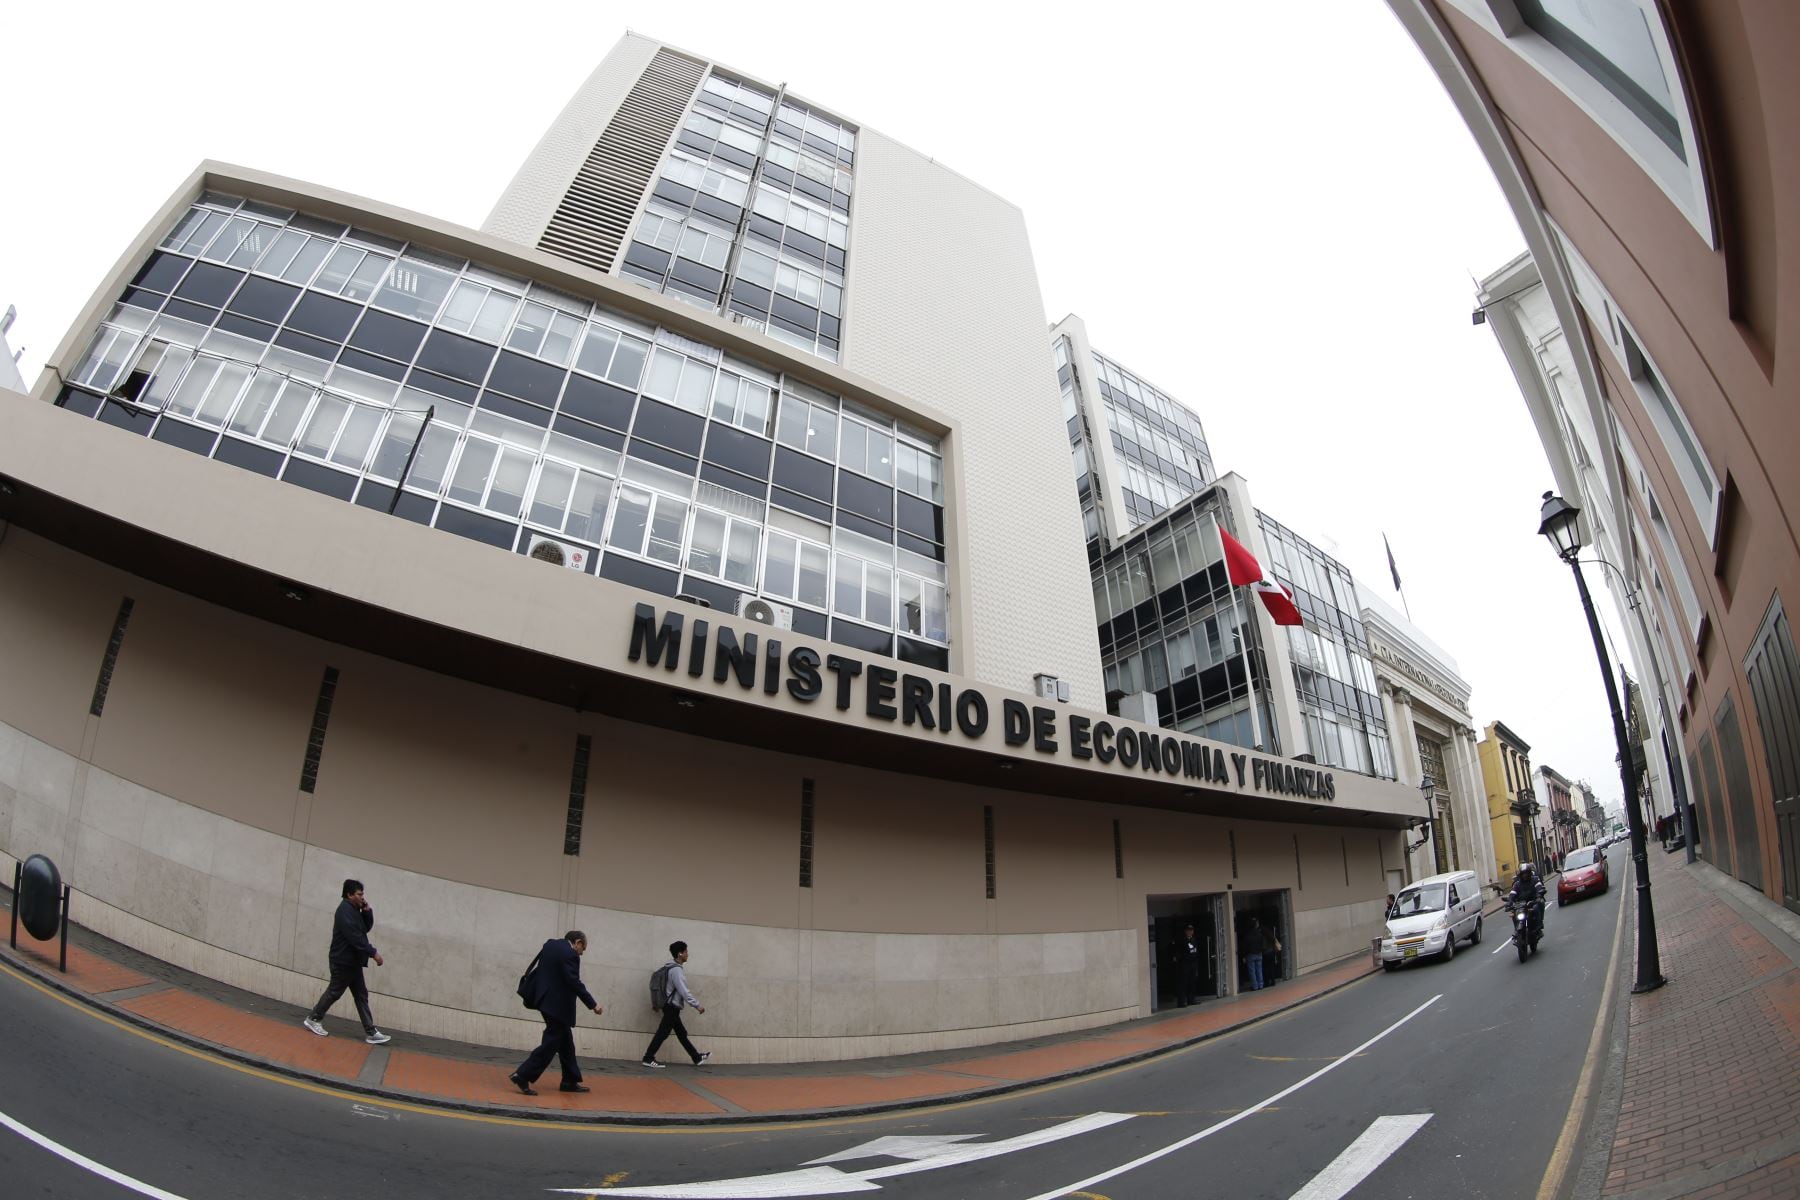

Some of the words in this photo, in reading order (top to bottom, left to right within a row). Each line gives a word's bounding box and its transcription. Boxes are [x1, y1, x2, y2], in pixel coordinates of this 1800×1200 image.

[628, 602, 989, 738] MINISTERIO
[1003, 698, 1058, 753] DE
[1068, 714, 1229, 784] ECONOMIA
[1231, 752, 1246, 787] Y
[1252, 758, 1335, 801] FINANZAS
